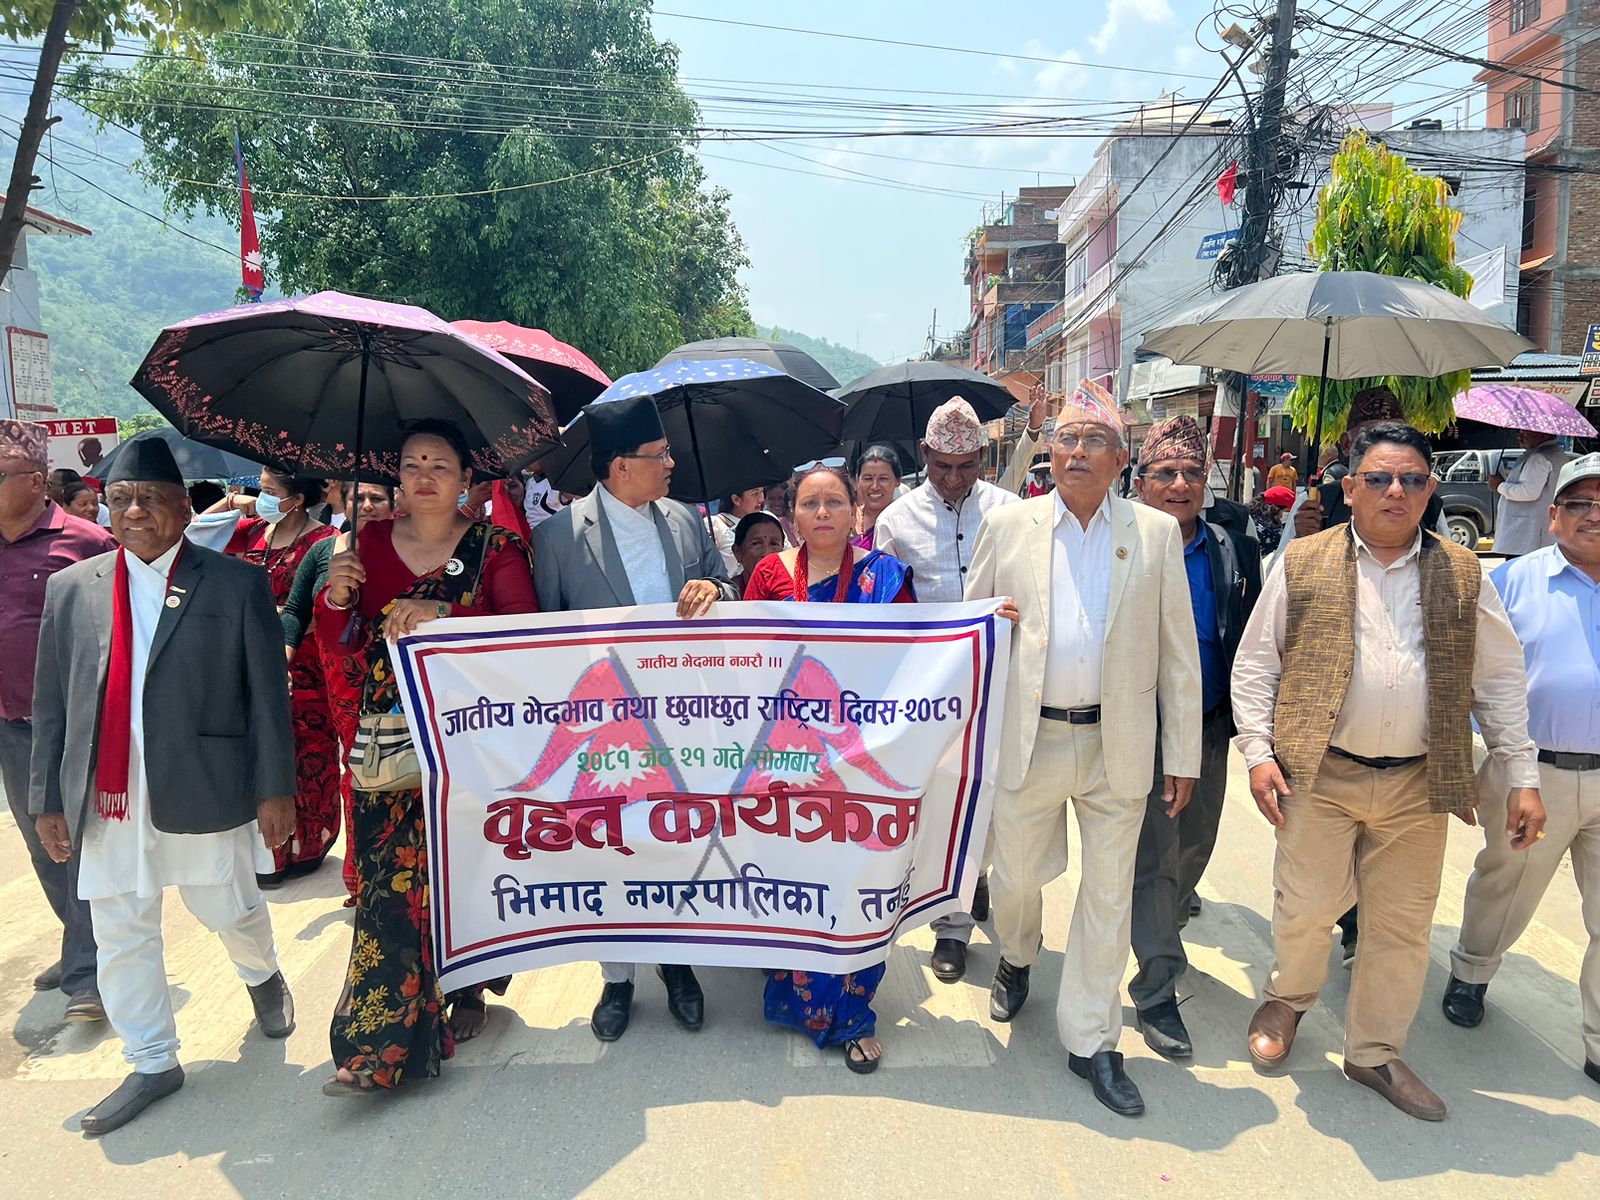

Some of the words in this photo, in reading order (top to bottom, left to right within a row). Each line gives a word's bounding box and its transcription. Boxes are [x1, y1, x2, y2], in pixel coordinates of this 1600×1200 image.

[637, 654, 678, 669] जातीय
[682, 653, 726, 668] भेदभाव
[729, 652, 764, 668] नगरौ
[441, 696, 515, 736] जातीय
[523, 696, 604, 725] भेदभाव
[612, 696, 658, 722] तथा
[665, 695, 750, 726] छुवाछुत
[758, 688, 832, 730] राष्ट्रिय
[839, 690, 963, 726] दिवस-२०८१
[577, 749, 630, 772] २०८१
[638, 742, 674, 769] जेठ
[680, 747, 705, 767] २१
[712, 741, 745, 770] गते
[751, 743, 827, 774] सोमबार
[483, 795, 636, 860] वृहत्
[647, 781, 927, 848] कार्यक्रम
[491, 873, 607, 922] भिमाद
[623, 863, 836, 930] नगरपालिका,
